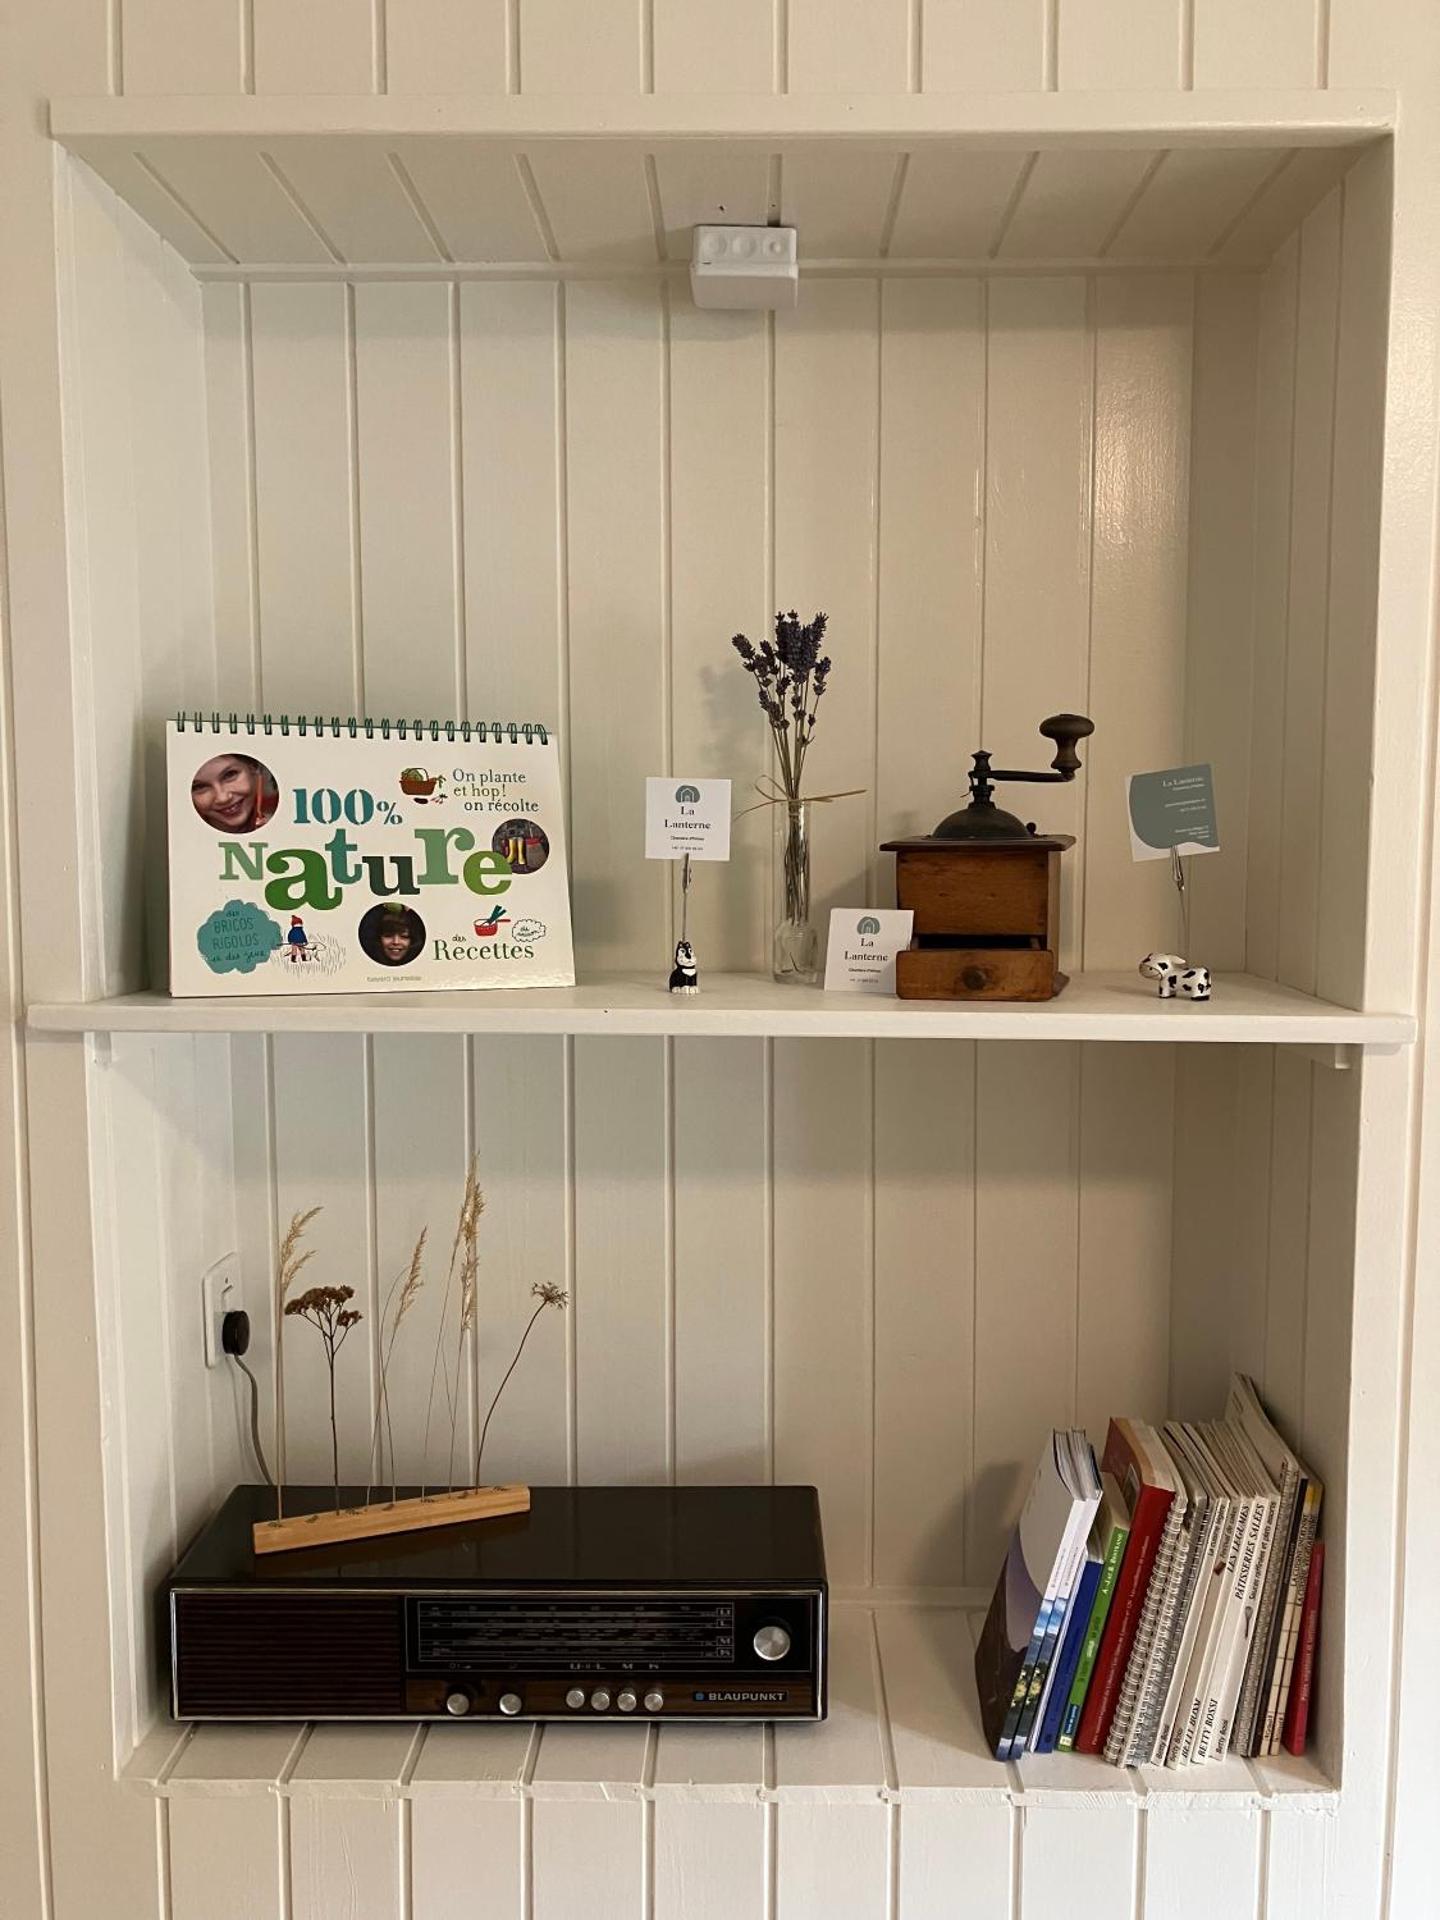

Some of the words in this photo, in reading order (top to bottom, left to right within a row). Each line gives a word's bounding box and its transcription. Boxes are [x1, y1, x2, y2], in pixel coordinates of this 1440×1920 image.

[453, 768, 475, 781] On
[480, 769, 526, 786] plante
[453, 787, 467, 797] et
[464, 801, 483, 811] on
[488, 798, 540, 812] récolte
[680, 806, 695, 816] La
[664, 819, 711, 830] Lanterne
[218, 827, 513, 911] Nature
[213, 917, 255, 934] BRICOS
[212, 933, 260, 951] RIGOLOS
[433, 939, 535, 961] Recettes
[860, 938, 874, 947] La
[844, 951, 888, 961] Lanterne
[1227, 1555, 1237, 1573] LES
[1235, 1541, 1256, 1600] PÂTISSERIES
[708, 1692, 785, 1701] BLAUPUNKT
[1198, 1729, 1212, 1757] BETTY
[1205, 1697, 1218, 1727] BOSSI
[1215, 1736, 1225, 1754] Betty
